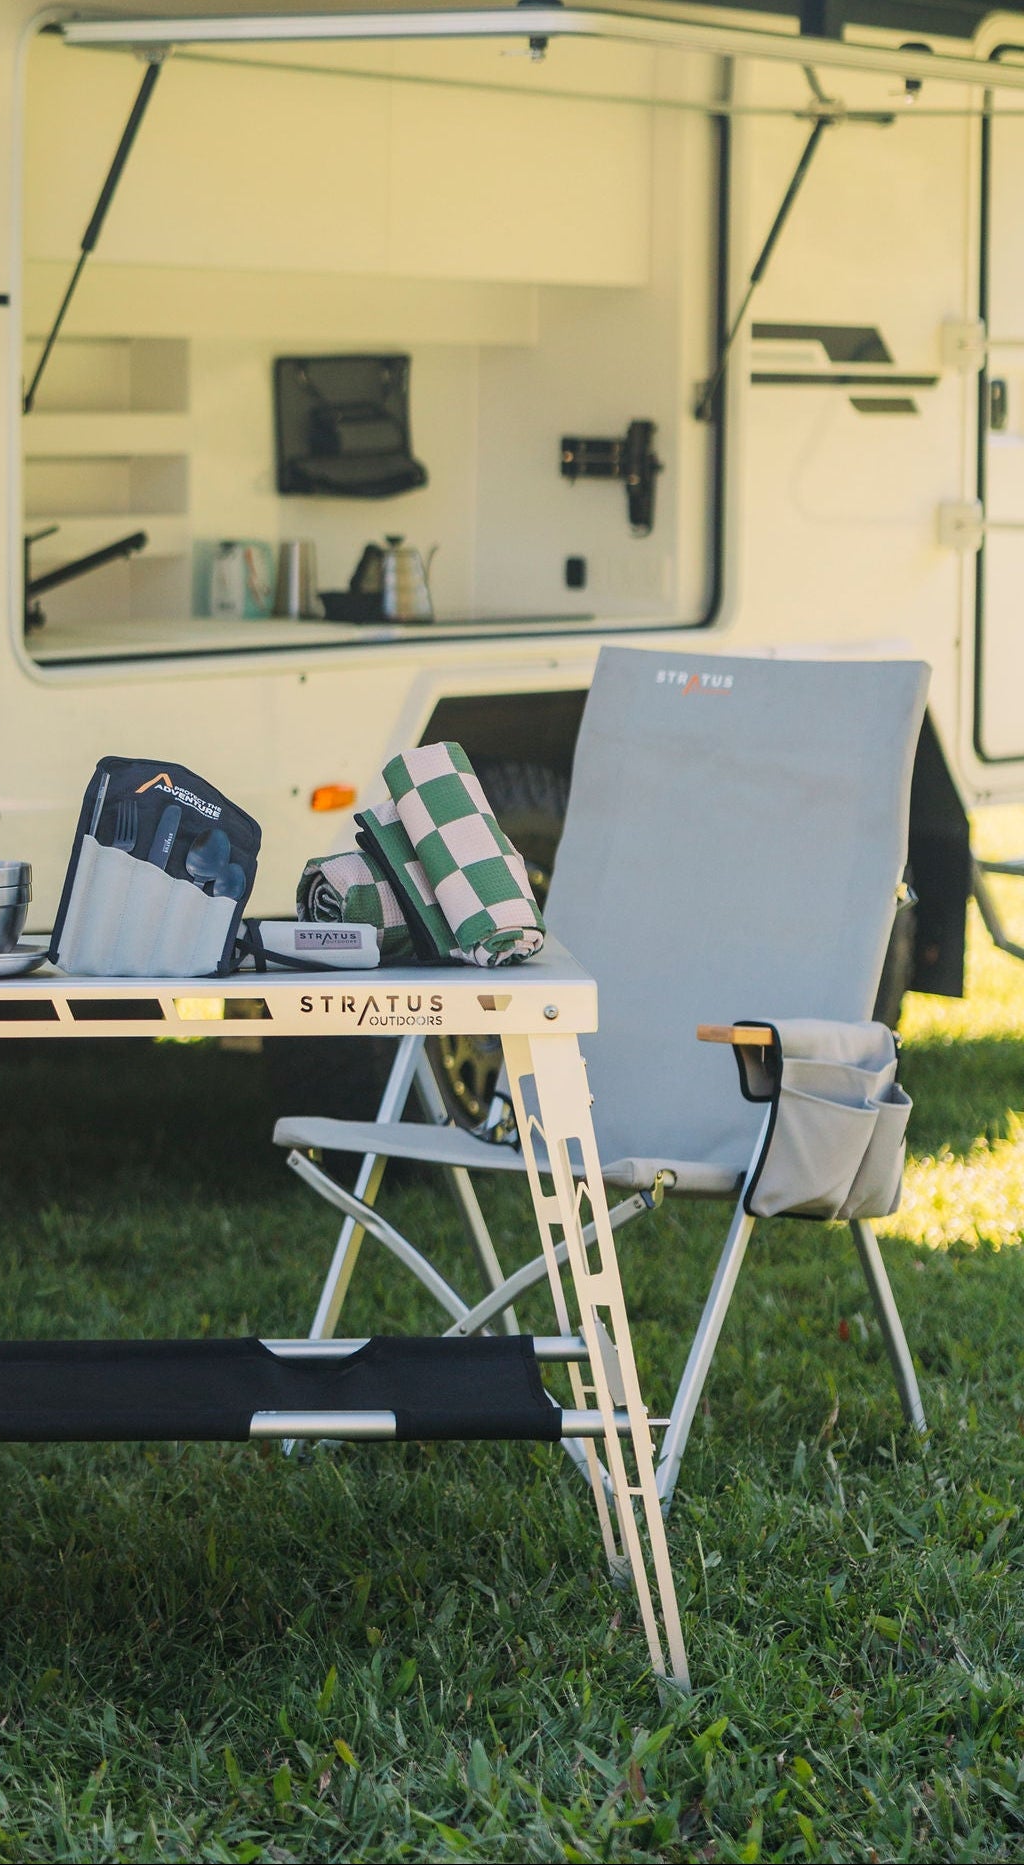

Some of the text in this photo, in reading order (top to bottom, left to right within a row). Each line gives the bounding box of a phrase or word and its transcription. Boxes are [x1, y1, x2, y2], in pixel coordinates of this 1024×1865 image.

[656, 669, 734, 697] STRATUS
[154, 784, 221, 818] ADVENTURE
[174, 785, 222, 813] PROTECT THE
[299, 932, 357, 945] STRATUS
[300, 995, 443, 1026] STRATUS
[369, 1015, 443, 1026] OUTDOORS
